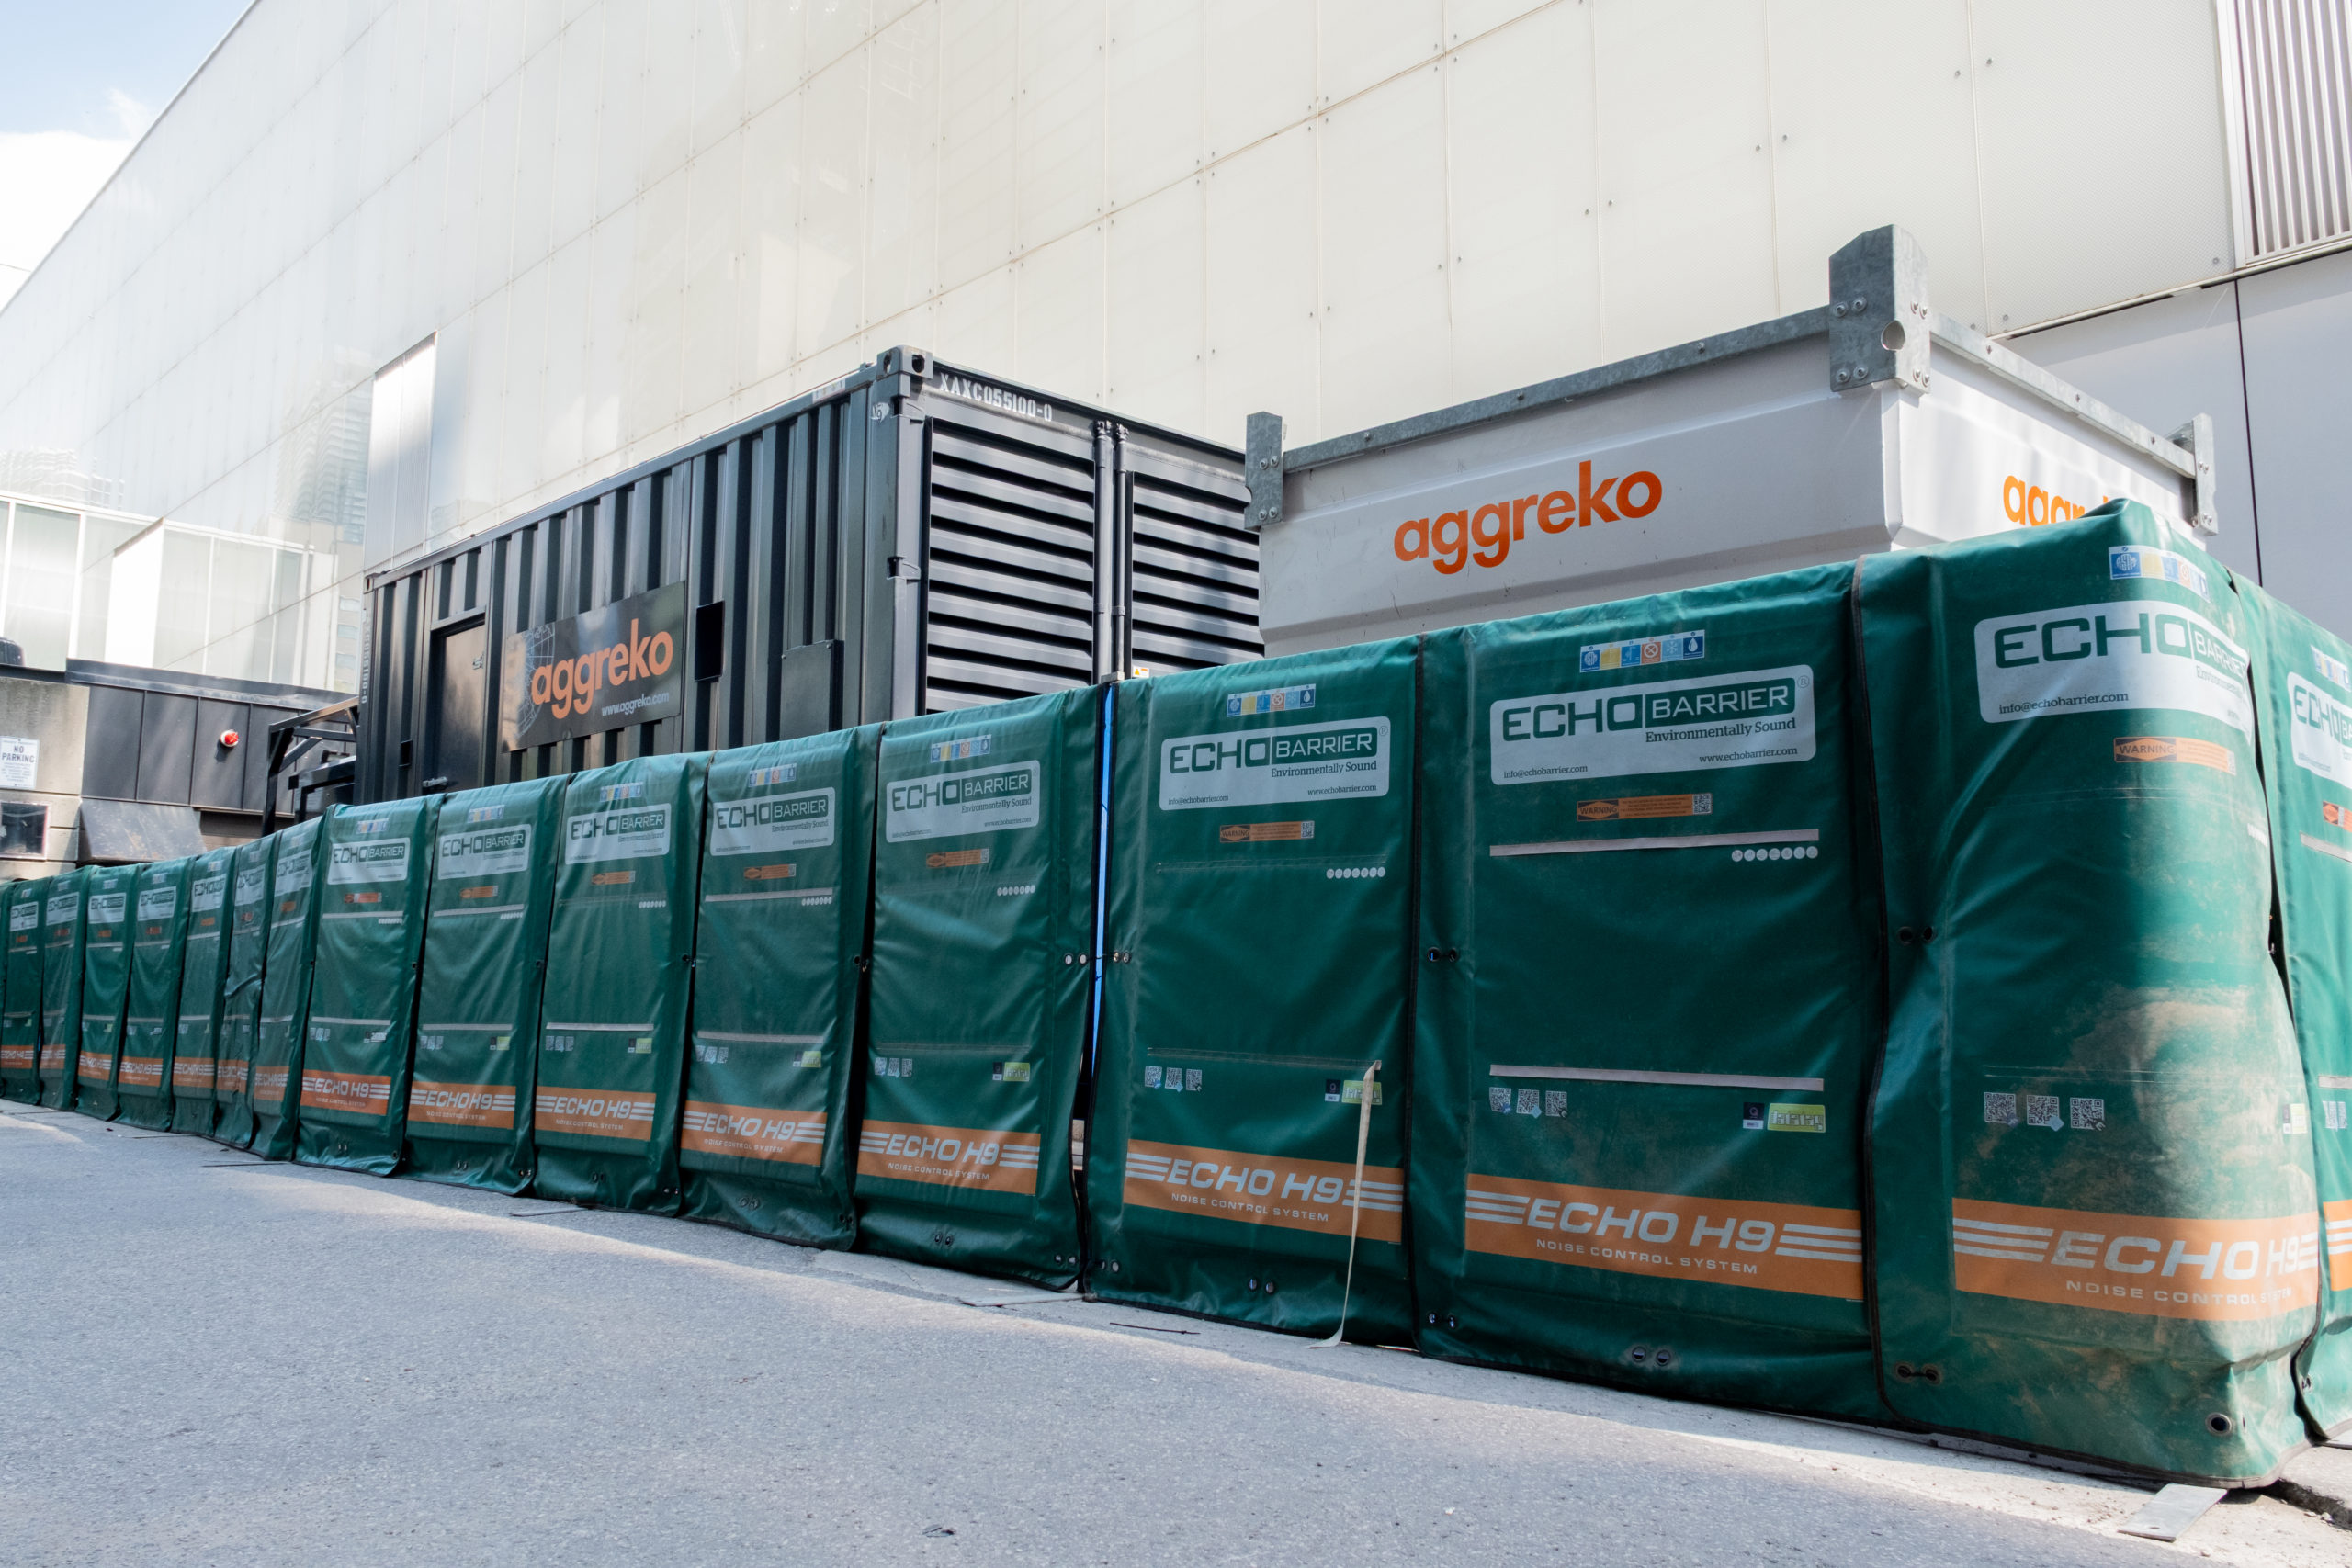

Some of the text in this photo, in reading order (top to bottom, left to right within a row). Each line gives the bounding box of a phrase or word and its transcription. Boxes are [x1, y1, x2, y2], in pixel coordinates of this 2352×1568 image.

[940, 372, 1052, 422] XAXC055100-0
[1394, 459, 1662, 575] aggreko
[1994, 612, 2191, 669] ECHO
[531, 618, 673, 719] aggreko
[601, 692, 670, 716] www.aggreko.com
[1502, 685, 1789, 741] ECHO BARRIER
[1998, 692, 2130, 715] info@echobarrier.com
[2293, 685, 2342, 743] ECHO
[1645, 717, 1796, 743] Environmentally Sound
[2, 753, 35, 763] PARKING
[14, 745, 25, 753] NO
[1170, 733, 1373, 773] ECHO BARRIER
[1699, 747, 1798, 764] www.echobarrier.com
[2119, 745, 2176, 754] WARNING
[1271, 761, 1377, 778] Environmentally Sound
[1503, 764, 1589, 779] info@echobarrier.com
[892, 773, 1029, 812] ECHO BARRIER
[1168, 795, 1229, 806] info@echobarrier.com
[1307, 784, 1377, 796] www.echobarrier.com
[717, 799, 826, 829] ECHO BARRIER
[961, 796, 1032, 813] Environmentally Sound
[1580, 806, 1618, 815] WARNING
[571, 815, 619, 840] ECHO
[621, 814, 664, 829] BARRER
[334, 846, 404, 863] ECHO BARRIER
[442, 836, 483, 857] ECHO
[485, 833, 524, 849] BARRIER
[314, 1078, 369, 1098] ECHO H9
[425, 1091, 493, 1111] ECHO H9
[553, 1096, 631, 1119] ECHO H9
[702, 1113, 796, 1141] ECHO H9
[886, 1134, 1000, 1166] ECHO H9
[888, 1162, 990, 1180] NOISE CONTROL SYSTEM
[1166, 1158, 1344, 1204] ECHO H9
[1171, 1193, 1329, 1222] NOISE CONTROL SYSTEM
[1526, 1198, 1776, 1253] ECHO H9
[1536, 1238, 1758, 1274] NOISE CONTROL SYSTEM
[2051, 1230, 2300, 1280] ECHO H9
[2065, 1280, 2144, 1300] NOISE
[2154, 1290, 2257, 1306] CONTROL
